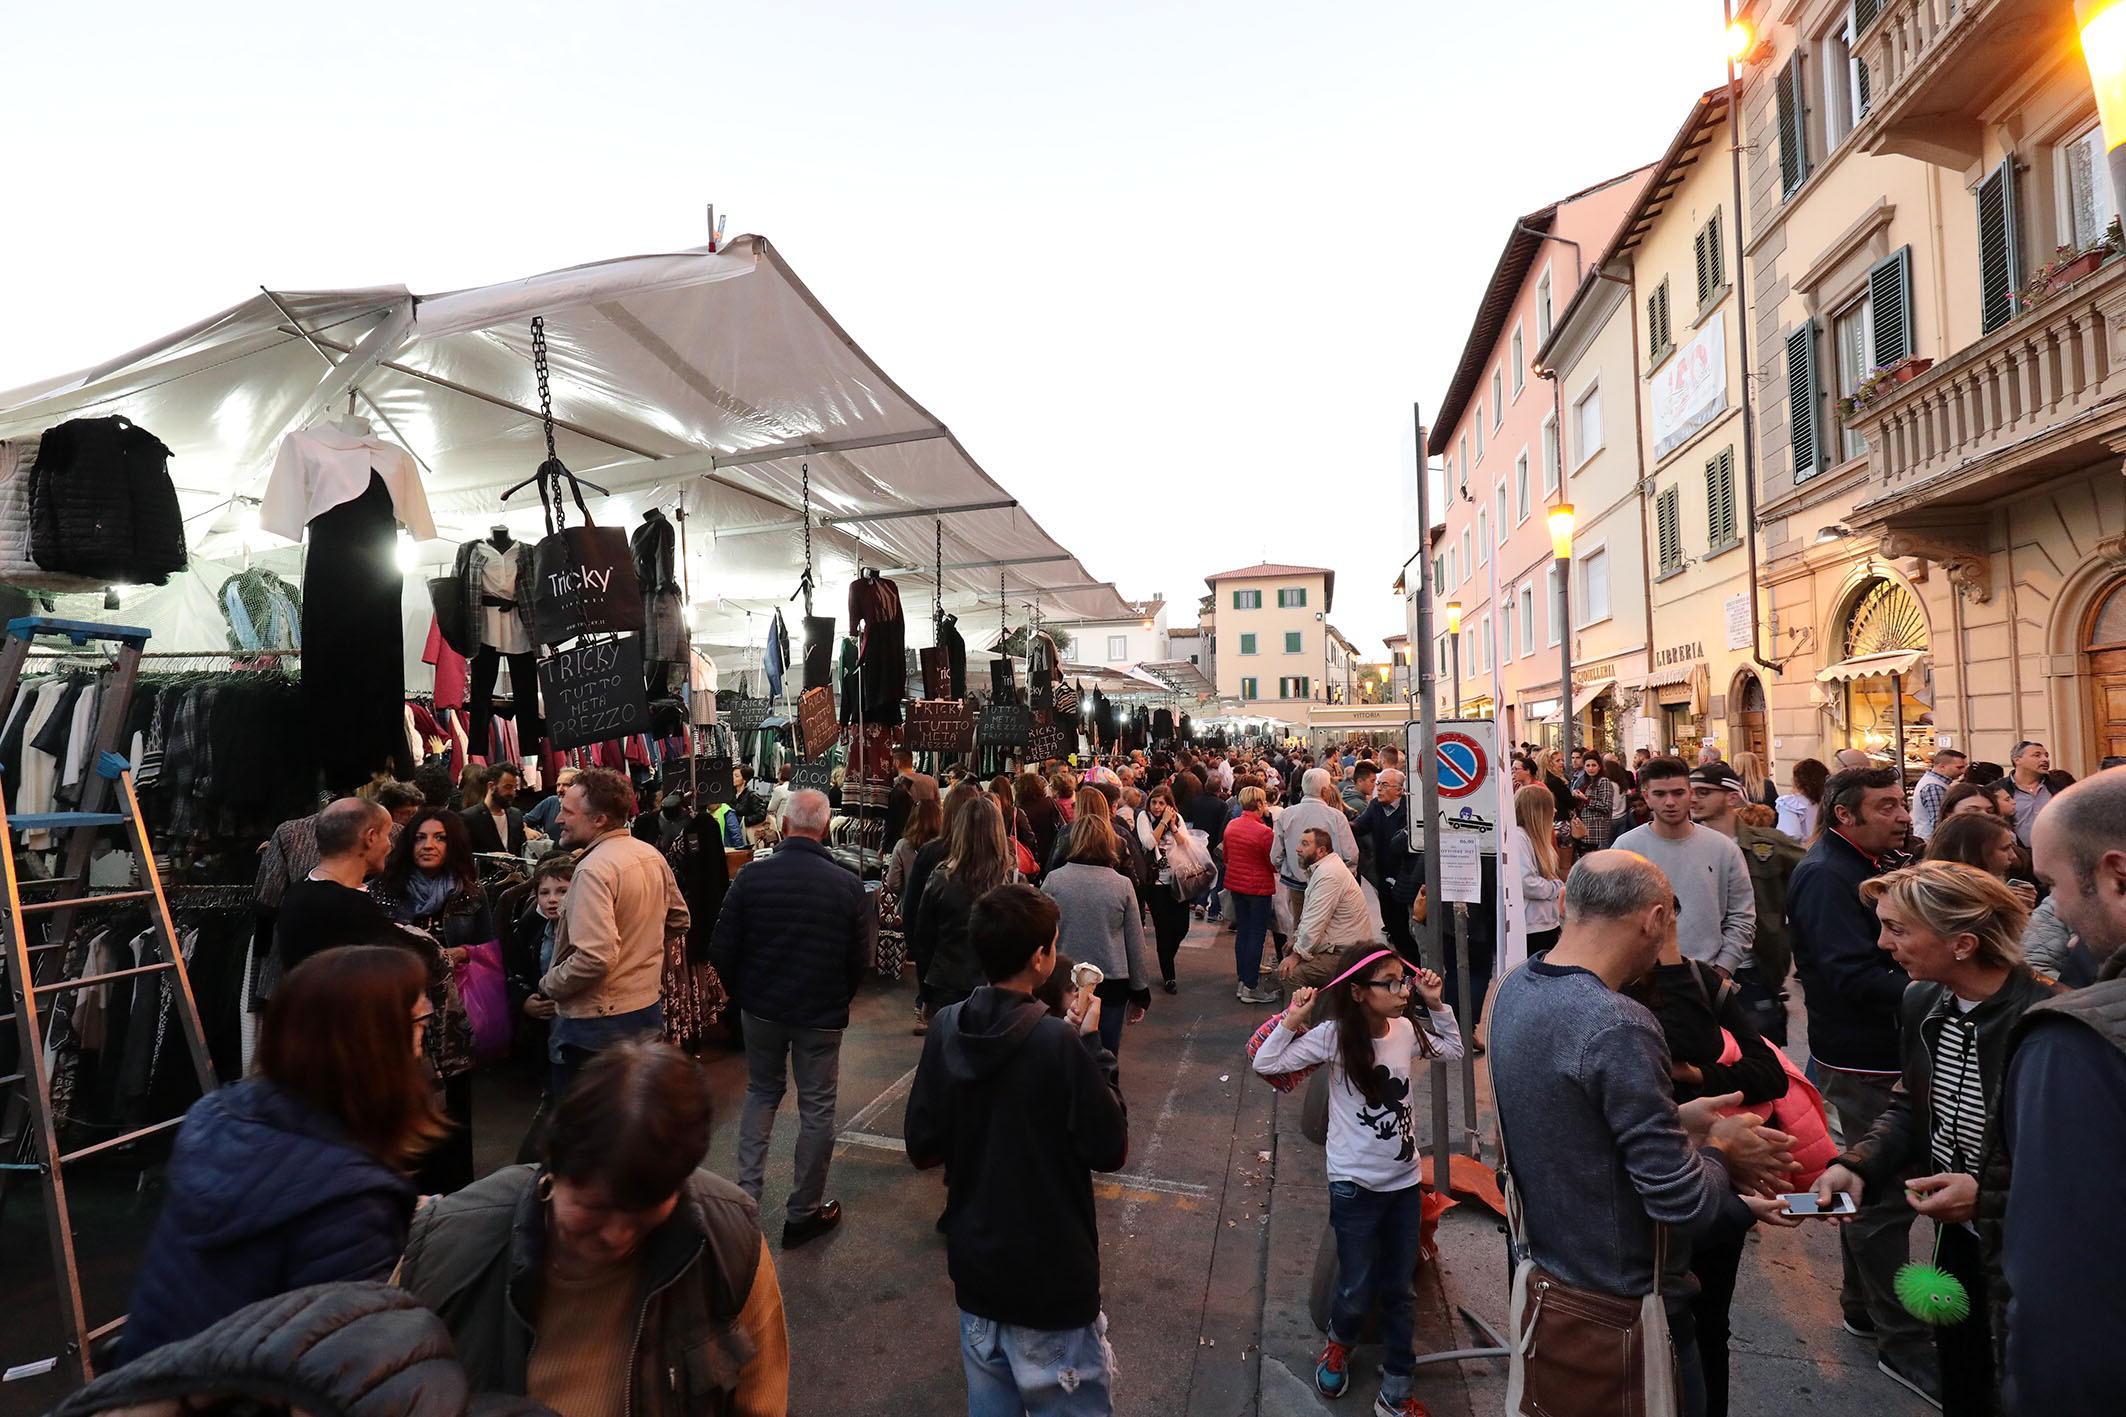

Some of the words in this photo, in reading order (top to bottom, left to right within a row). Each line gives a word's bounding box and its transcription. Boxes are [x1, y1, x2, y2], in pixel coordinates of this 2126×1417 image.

[548, 565, 611, 597] Tricky
[540, 644, 619, 683] TRICKY
[1656, 641, 1704, 667] LIBRERIA
[560, 675, 621, 703] TUTTO
[553, 703, 636, 744] PREZZO
[984, 706, 1020, 715] TUTTO
[913, 720, 969, 732] TUTTO
[1028, 725, 1057, 739] RICKY
